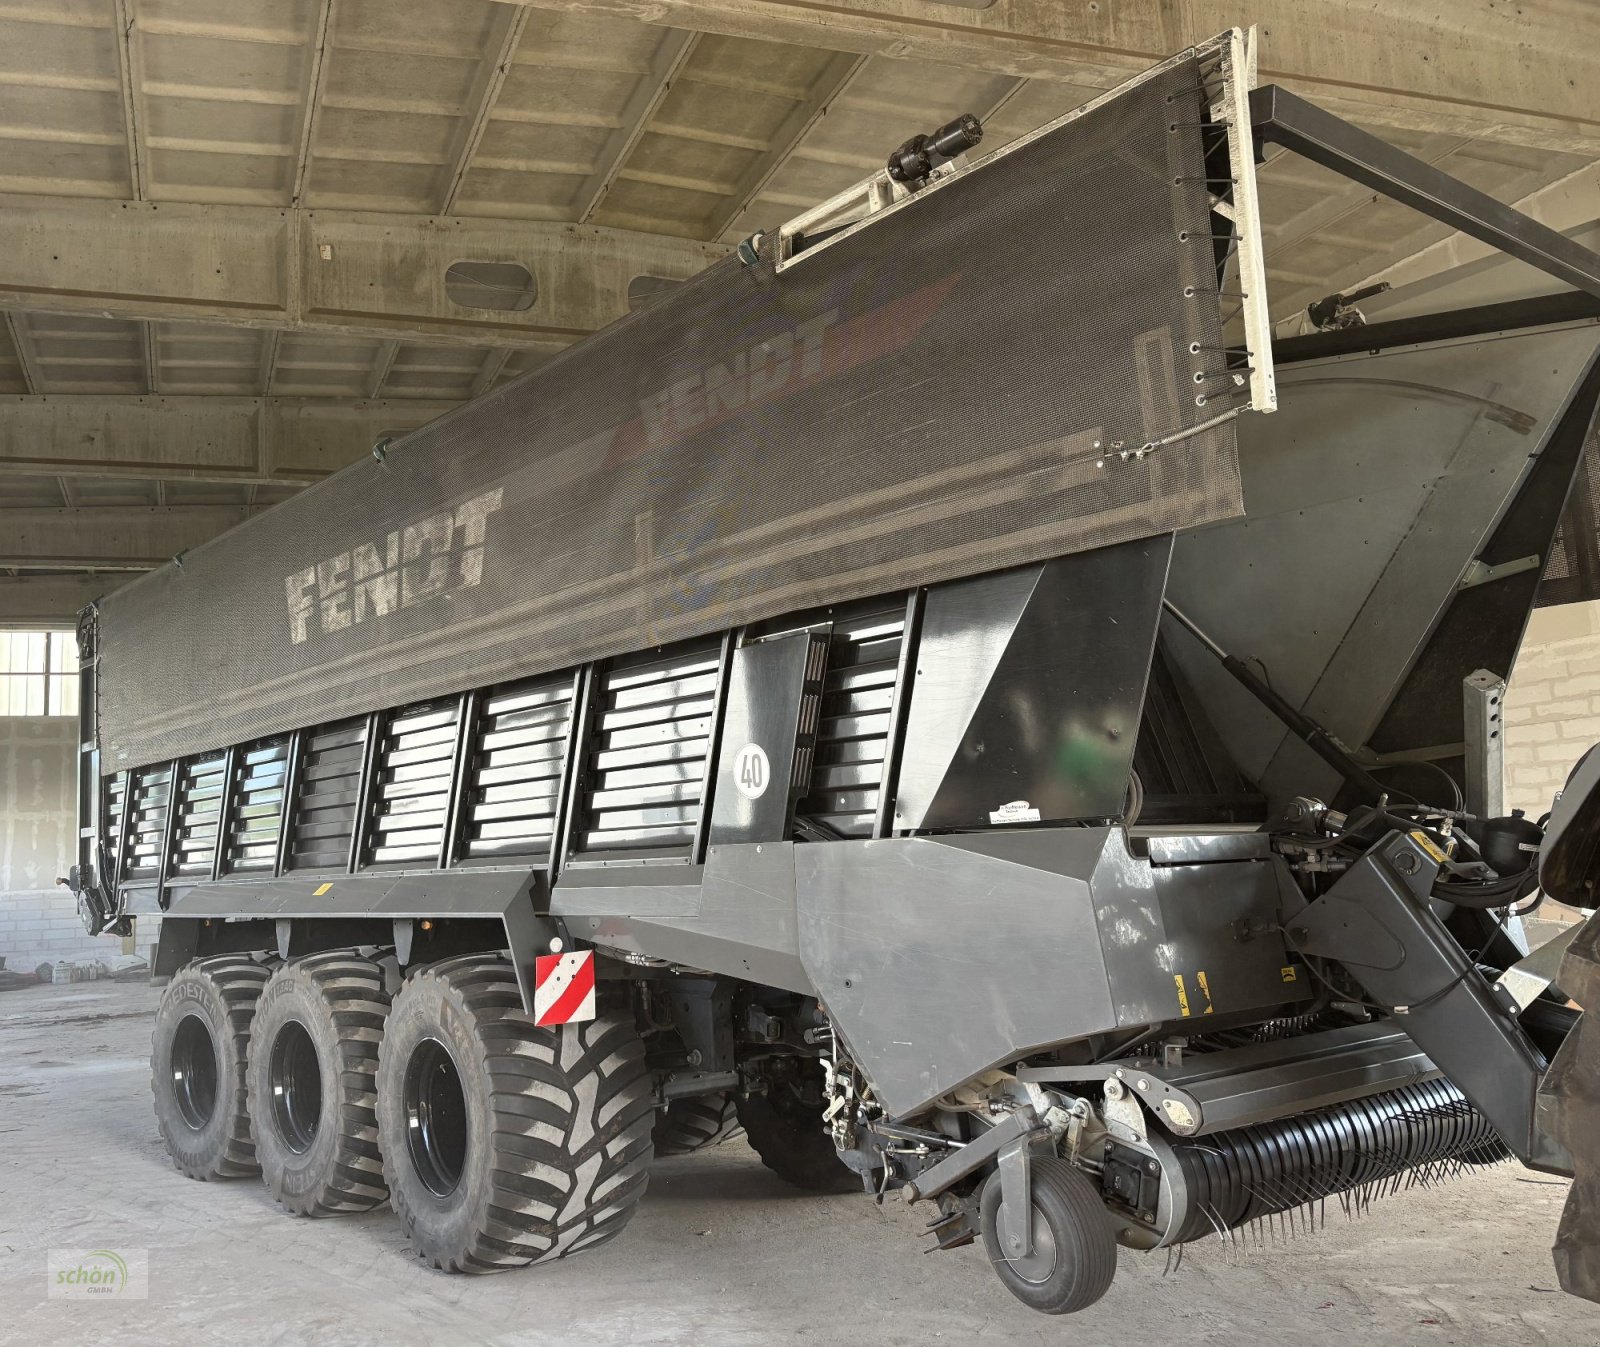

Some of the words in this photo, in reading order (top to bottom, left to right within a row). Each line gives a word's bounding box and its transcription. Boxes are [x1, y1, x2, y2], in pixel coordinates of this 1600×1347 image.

[639, 308, 840, 444] FENDT
[285, 487, 504, 645] FENDT
[740, 753, 763, 789] 40
